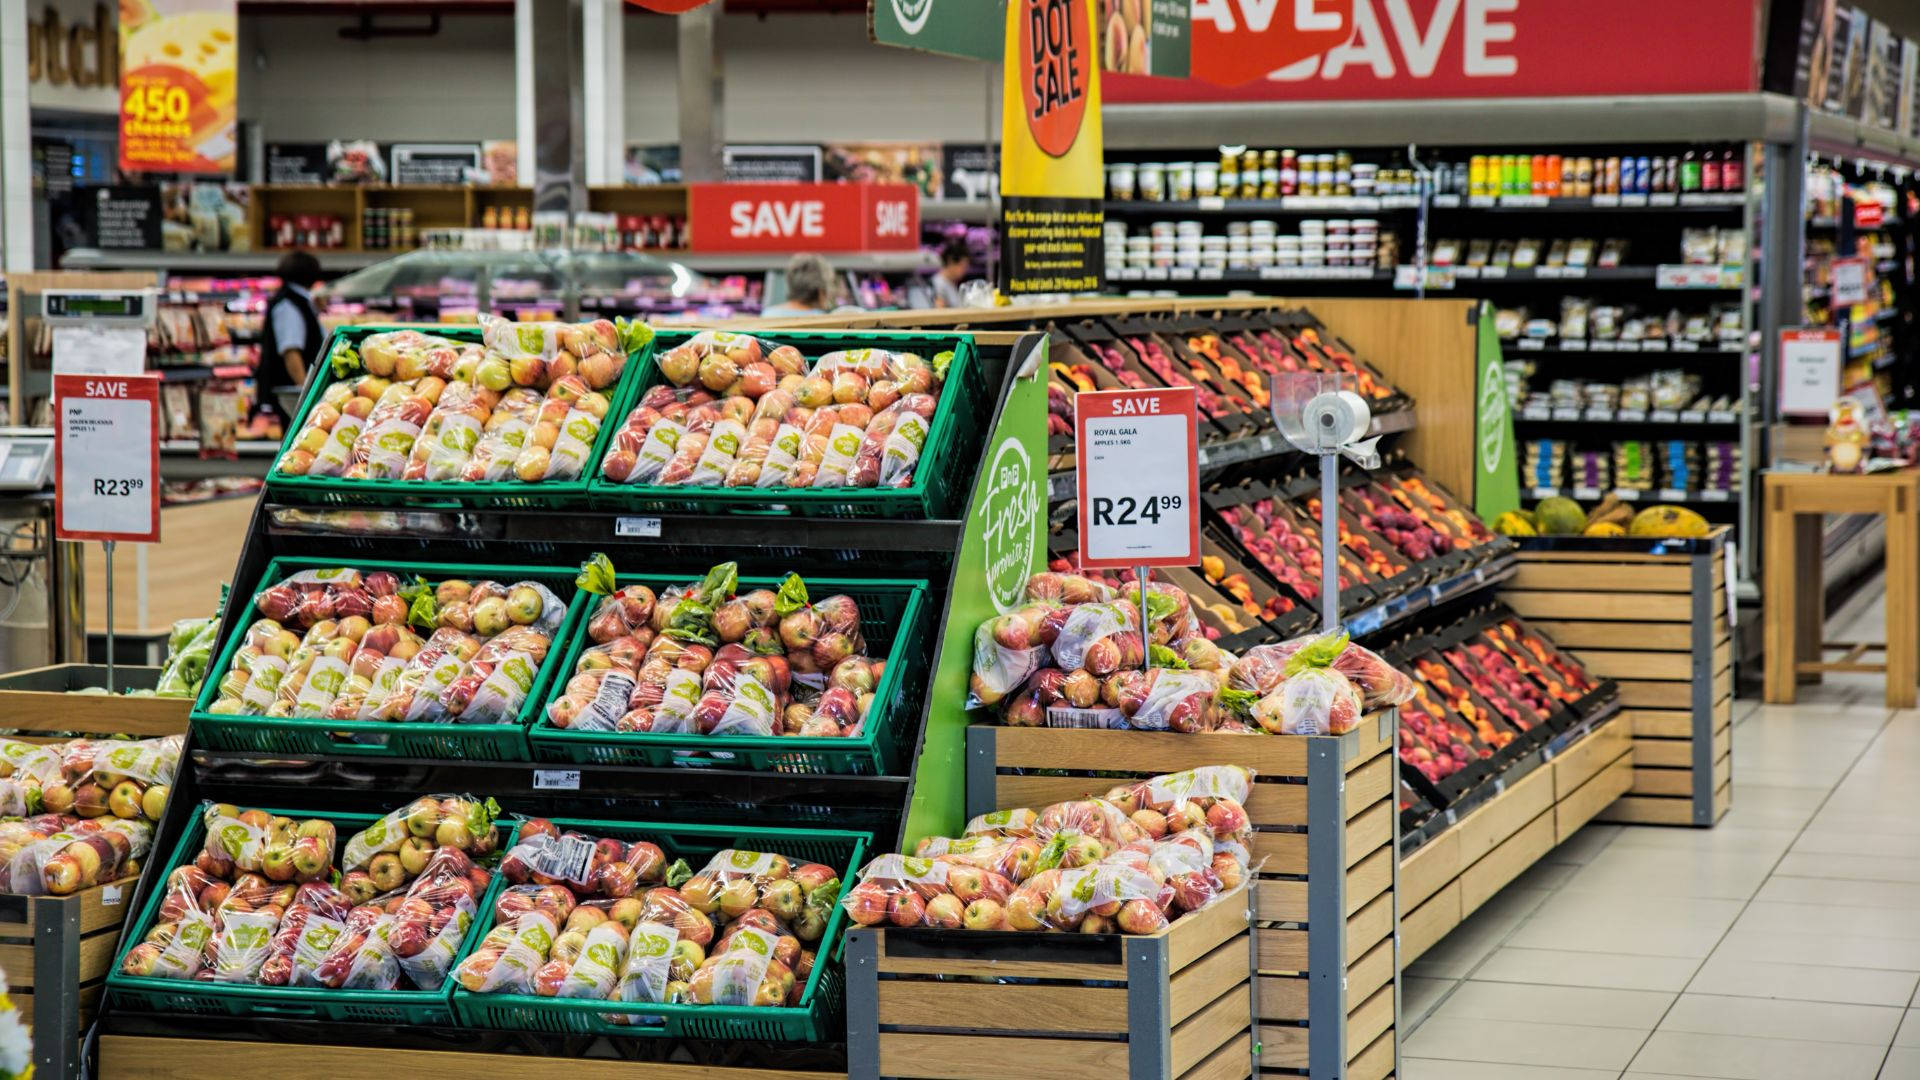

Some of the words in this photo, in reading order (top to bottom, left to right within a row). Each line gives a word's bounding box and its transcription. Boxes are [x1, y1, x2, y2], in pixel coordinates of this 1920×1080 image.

[1029, 0, 1075, 66] DOT
[1266, 0, 1518, 81] AVE
[123, 84, 190, 122] 450
[1033, 51, 1081, 119] SALE
[730, 201, 825, 237] SAVE
[875, 201, 909, 237] SAVE
[85, 381, 127, 398] SAVE
[1112, 398, 1160, 415] SAVE
[1094, 429, 1117, 437] ROYAL
[1119, 427, 1138, 436] GALA
[979, 455, 1041, 553] Fresh
